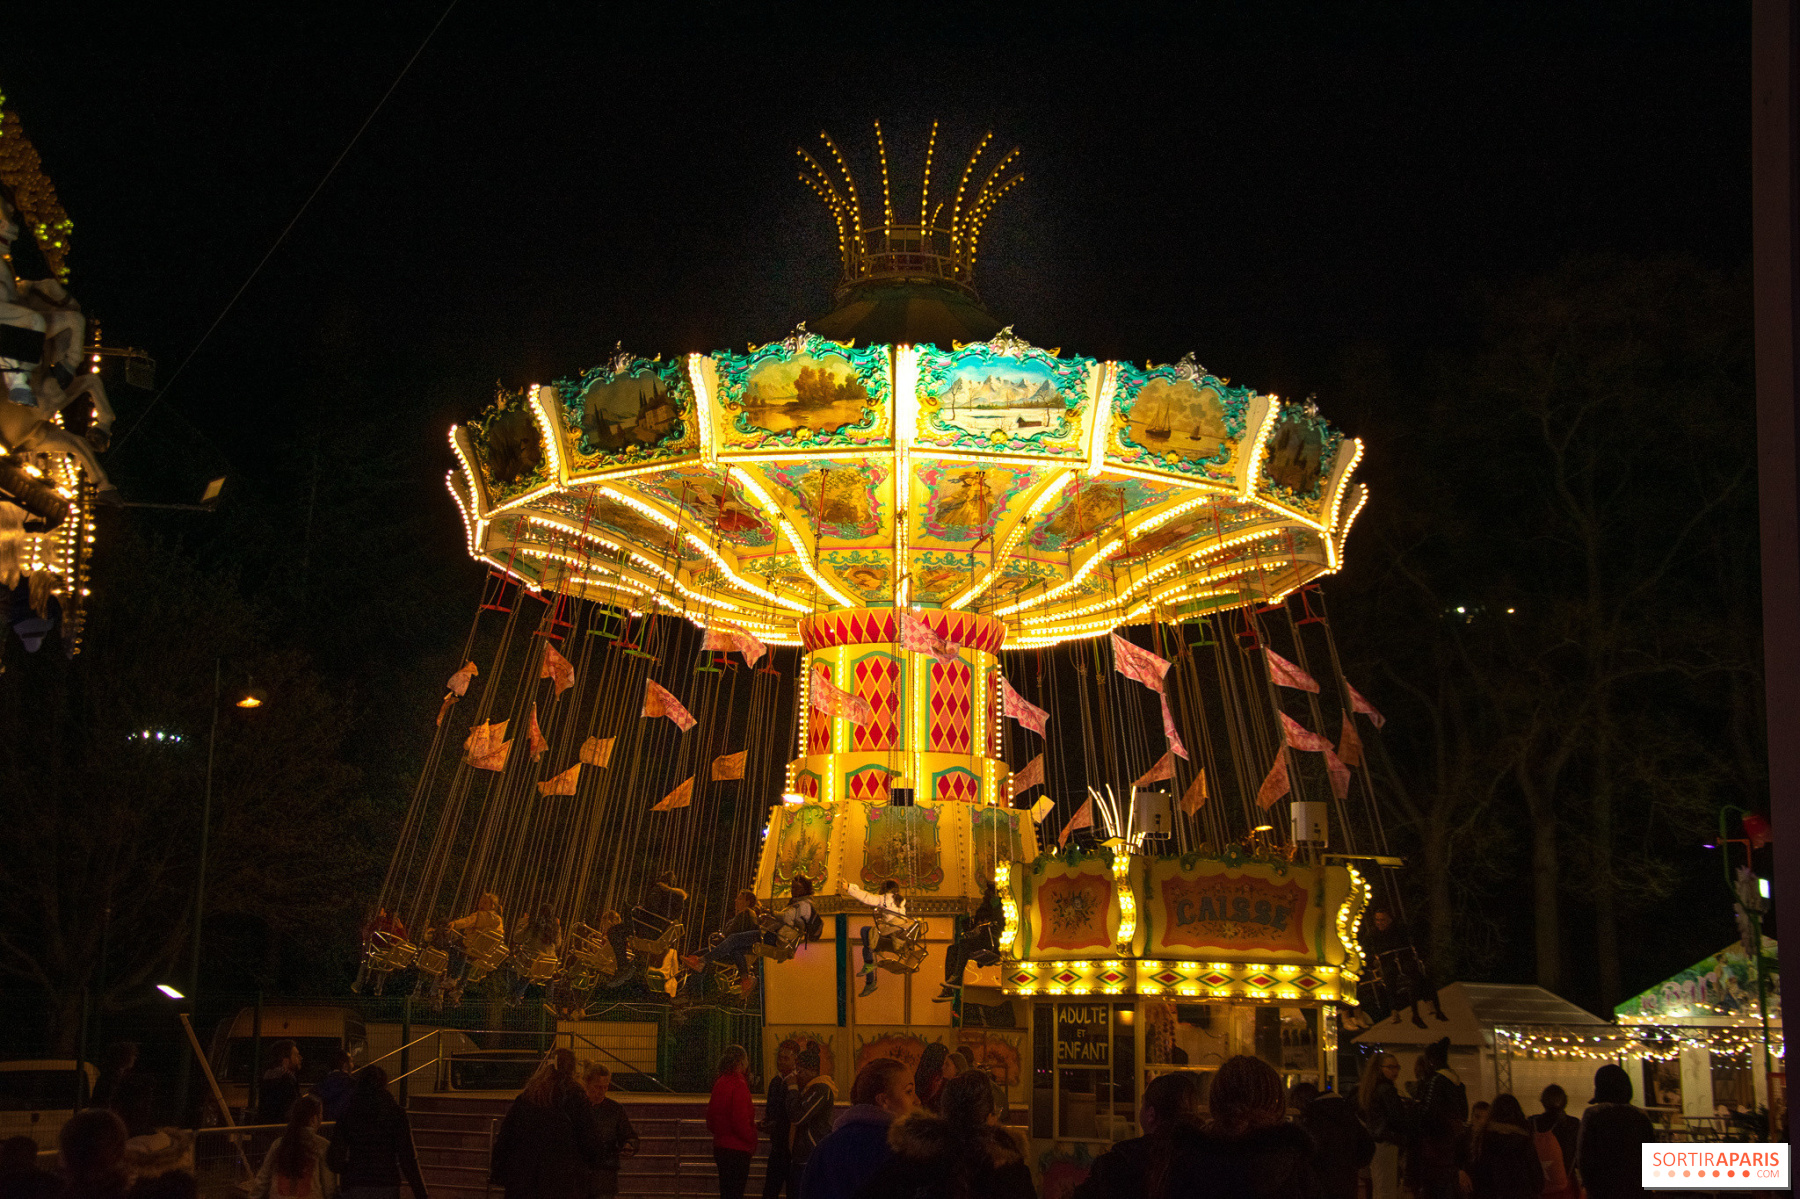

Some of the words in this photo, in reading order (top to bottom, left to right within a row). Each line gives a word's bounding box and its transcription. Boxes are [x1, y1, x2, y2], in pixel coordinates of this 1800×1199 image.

[1176, 895, 1292, 932] CAISSE
[1059, 1006, 1106, 1024] ADULTE
[1076, 1028, 1086, 1038] ET
[1058, 1041, 1108, 1060] ENFANT
